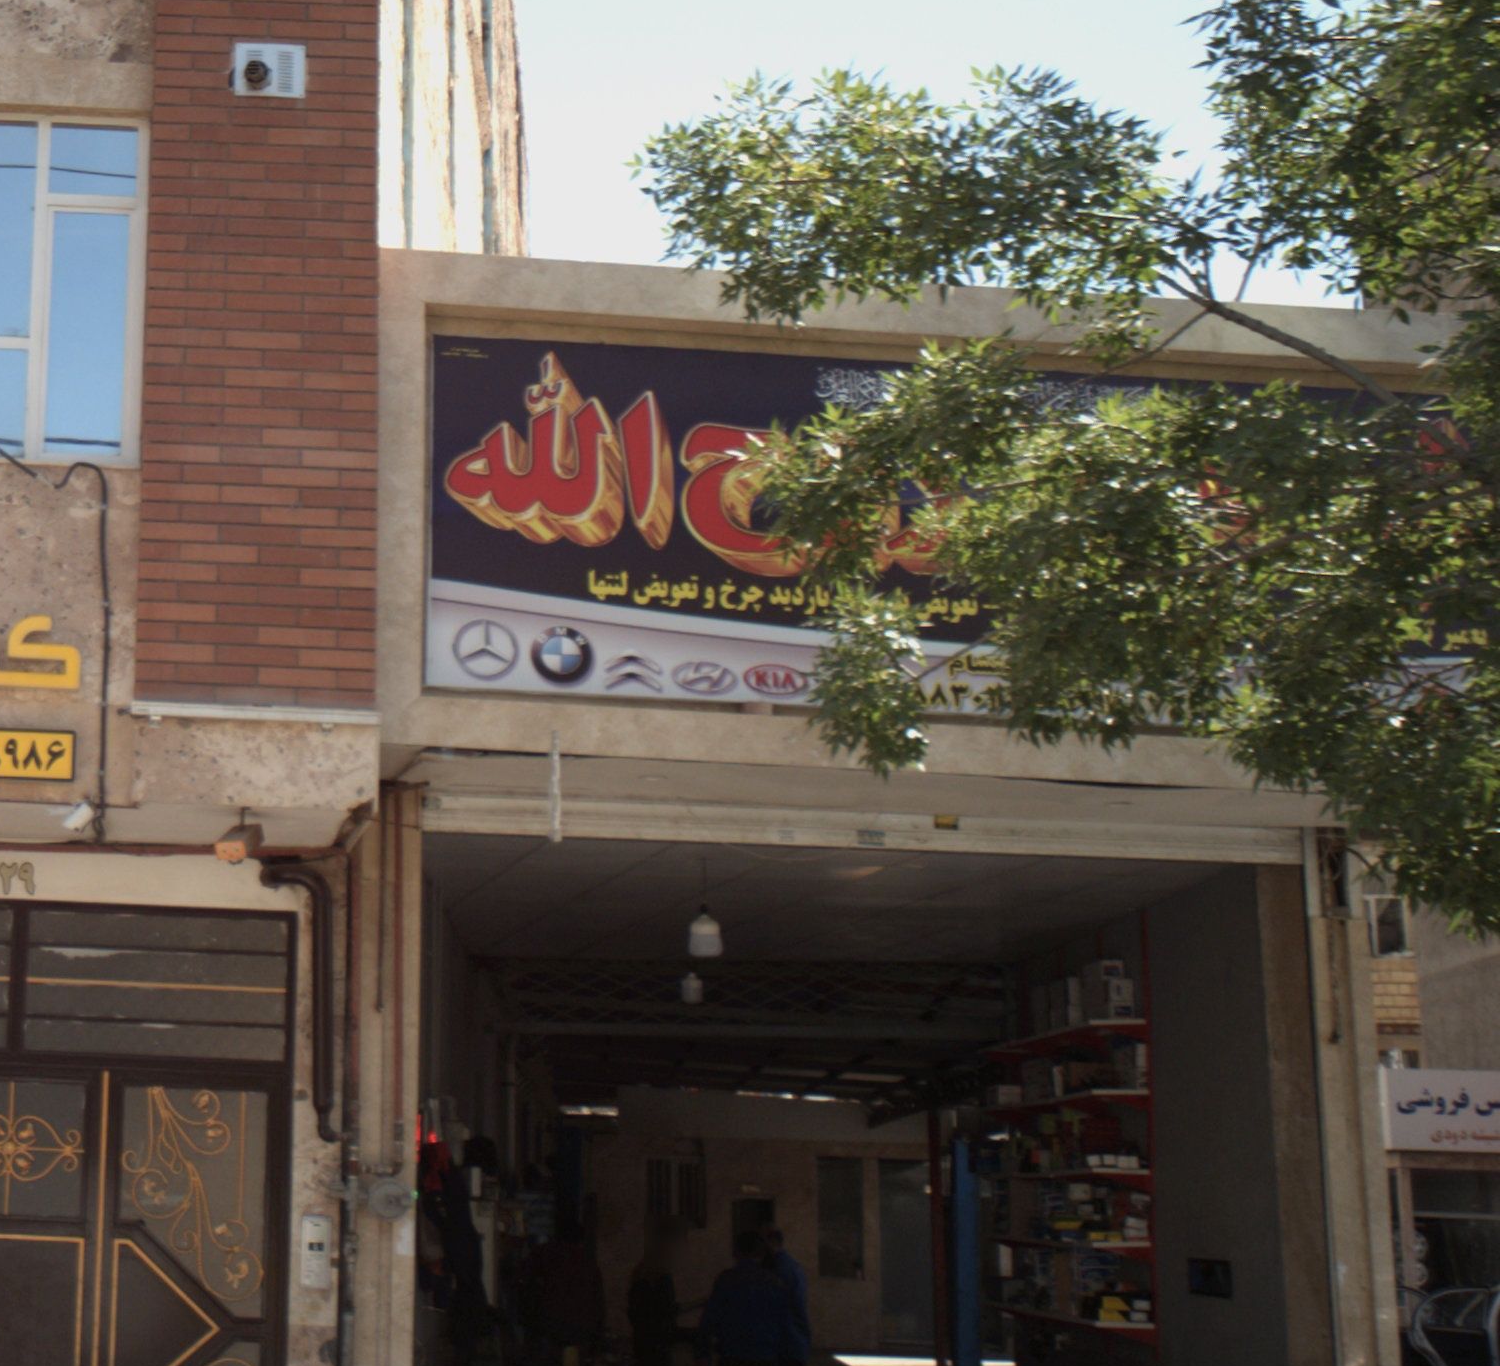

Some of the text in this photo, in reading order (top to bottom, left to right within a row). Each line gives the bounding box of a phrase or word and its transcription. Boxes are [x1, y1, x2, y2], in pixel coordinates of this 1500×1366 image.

[588, 569, 629, 601] لنتها
[633, 575, 699, 607] تعویض
[703, 586, 716, 610] و
[718, 579, 764, 612] چرخ
[1397, 1086, 1470, 1115] فروشی
